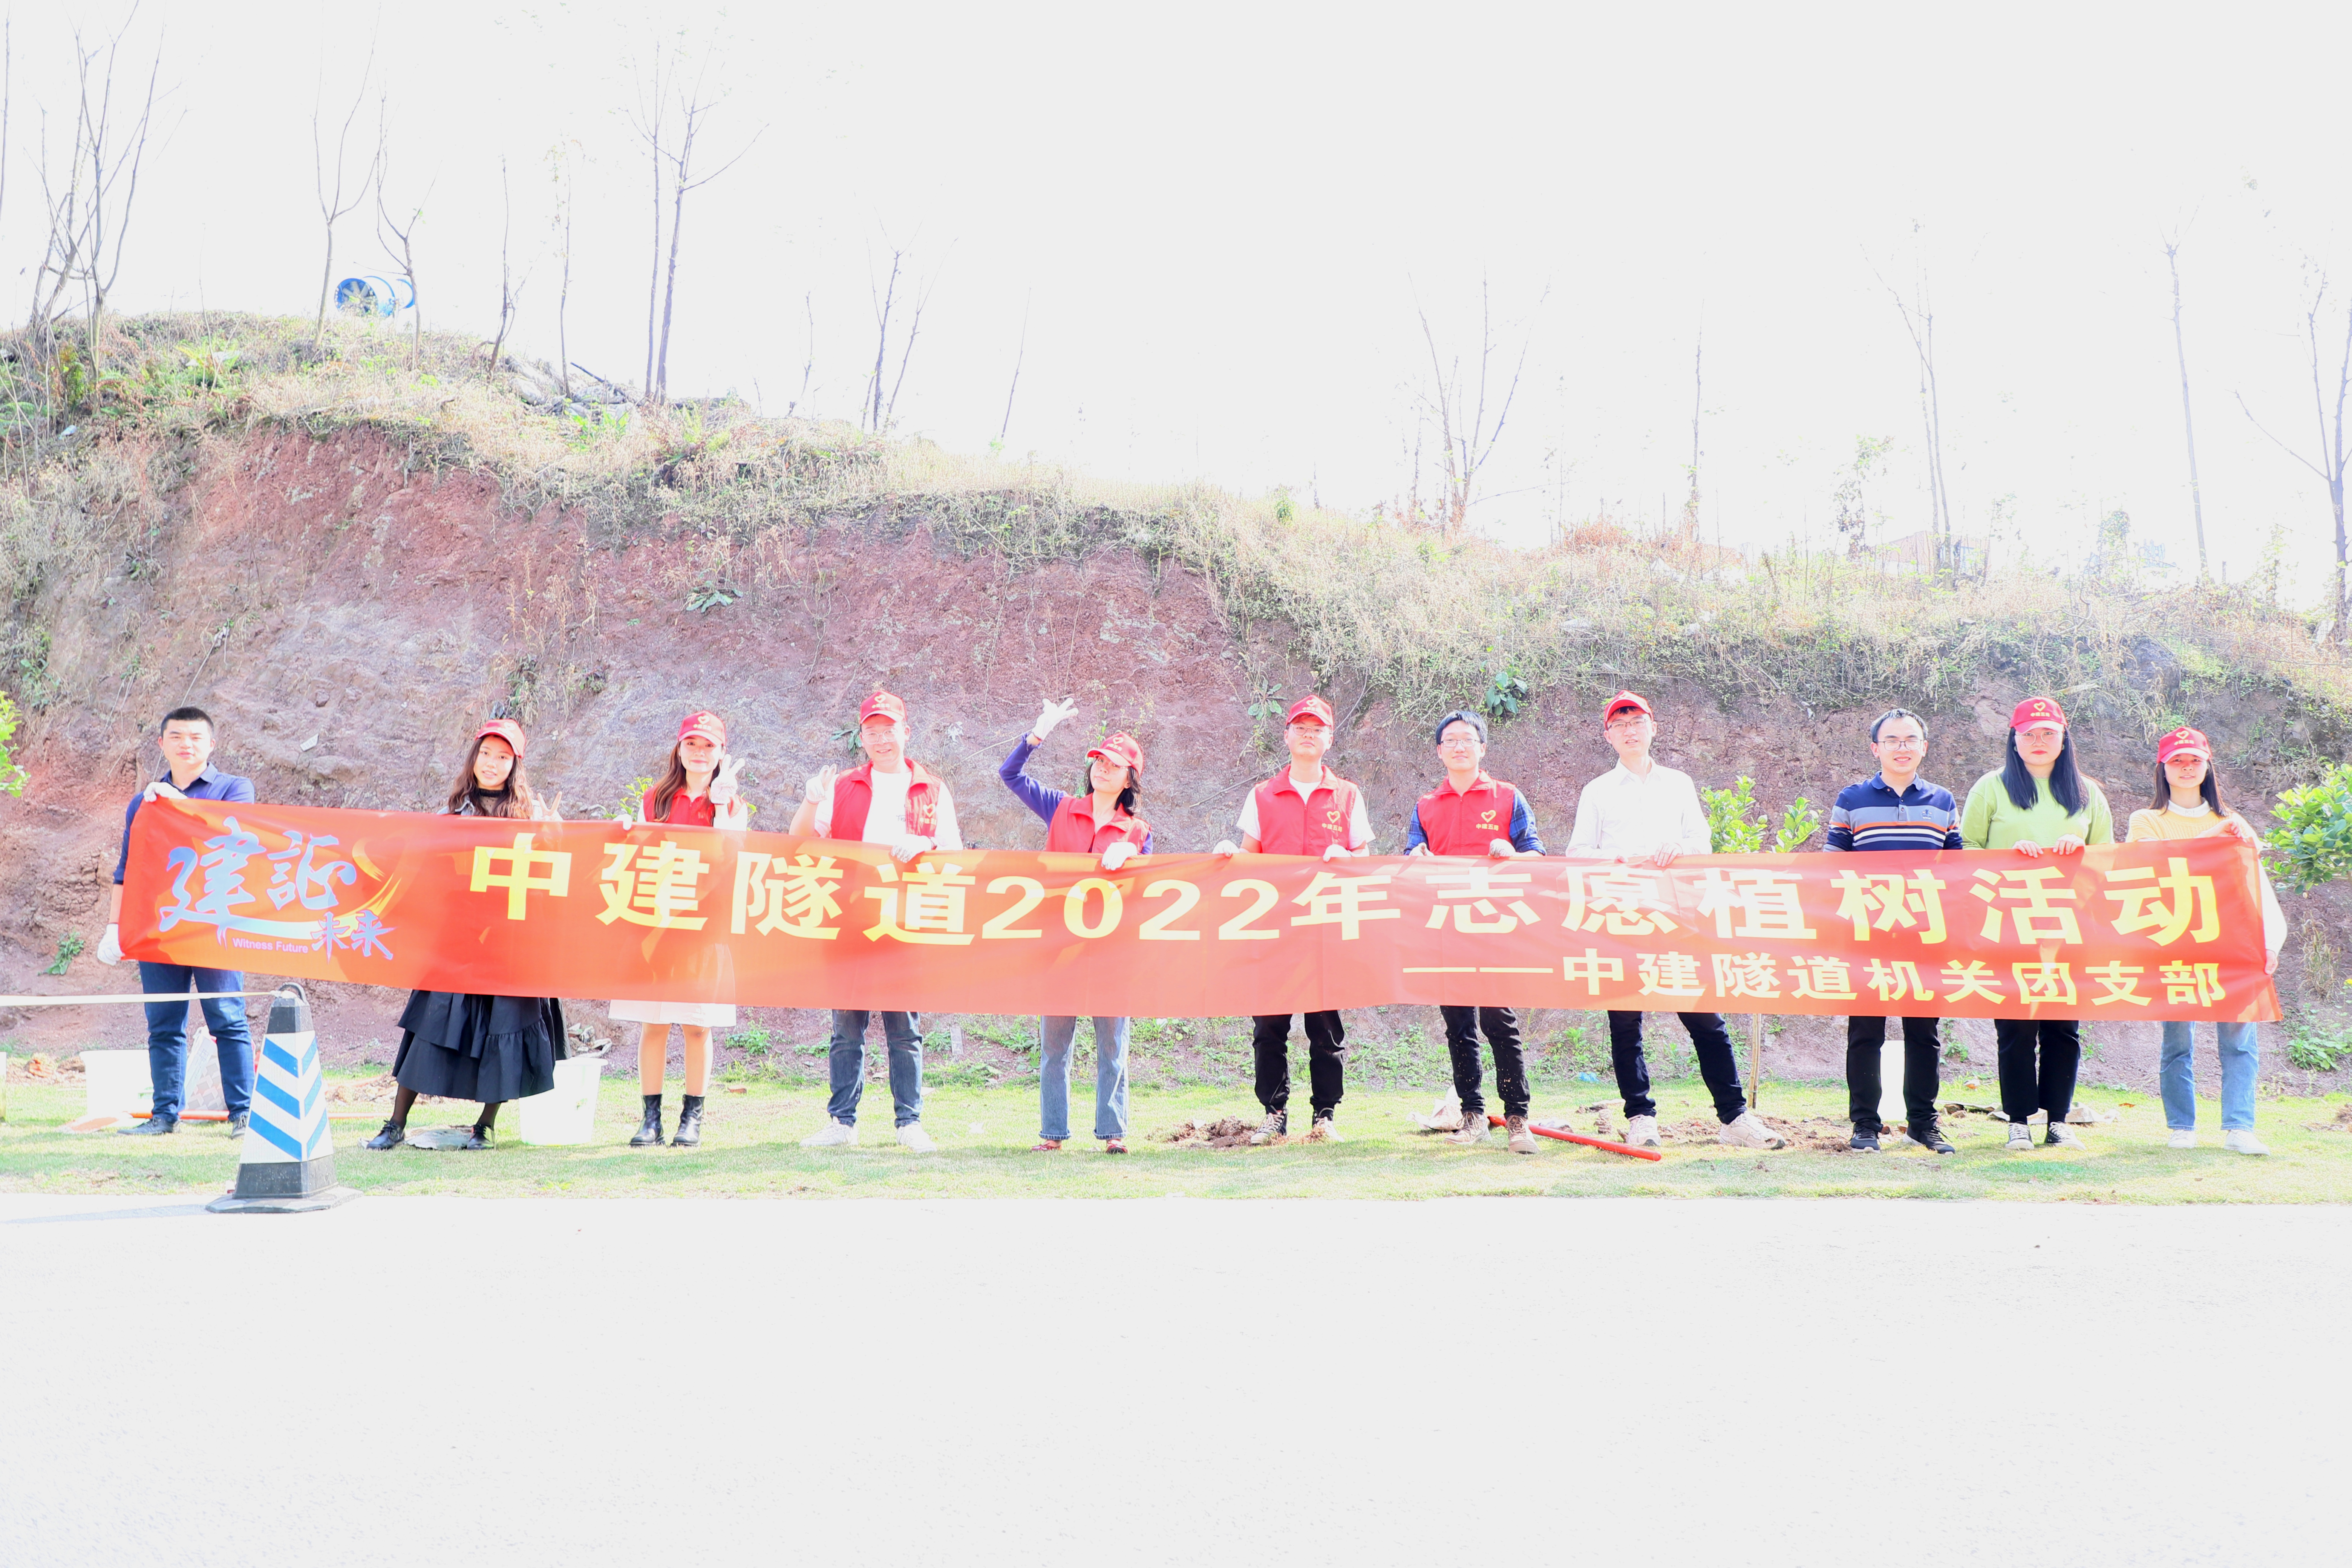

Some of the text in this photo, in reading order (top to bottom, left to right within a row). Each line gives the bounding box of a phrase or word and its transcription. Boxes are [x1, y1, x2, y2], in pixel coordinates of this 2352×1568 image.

[470, 832, 2220, 946] 中建隧道2022年志愿植树活动
[232, 937, 309, 954] Witness Future
[310, 910, 398, 963] 未来
